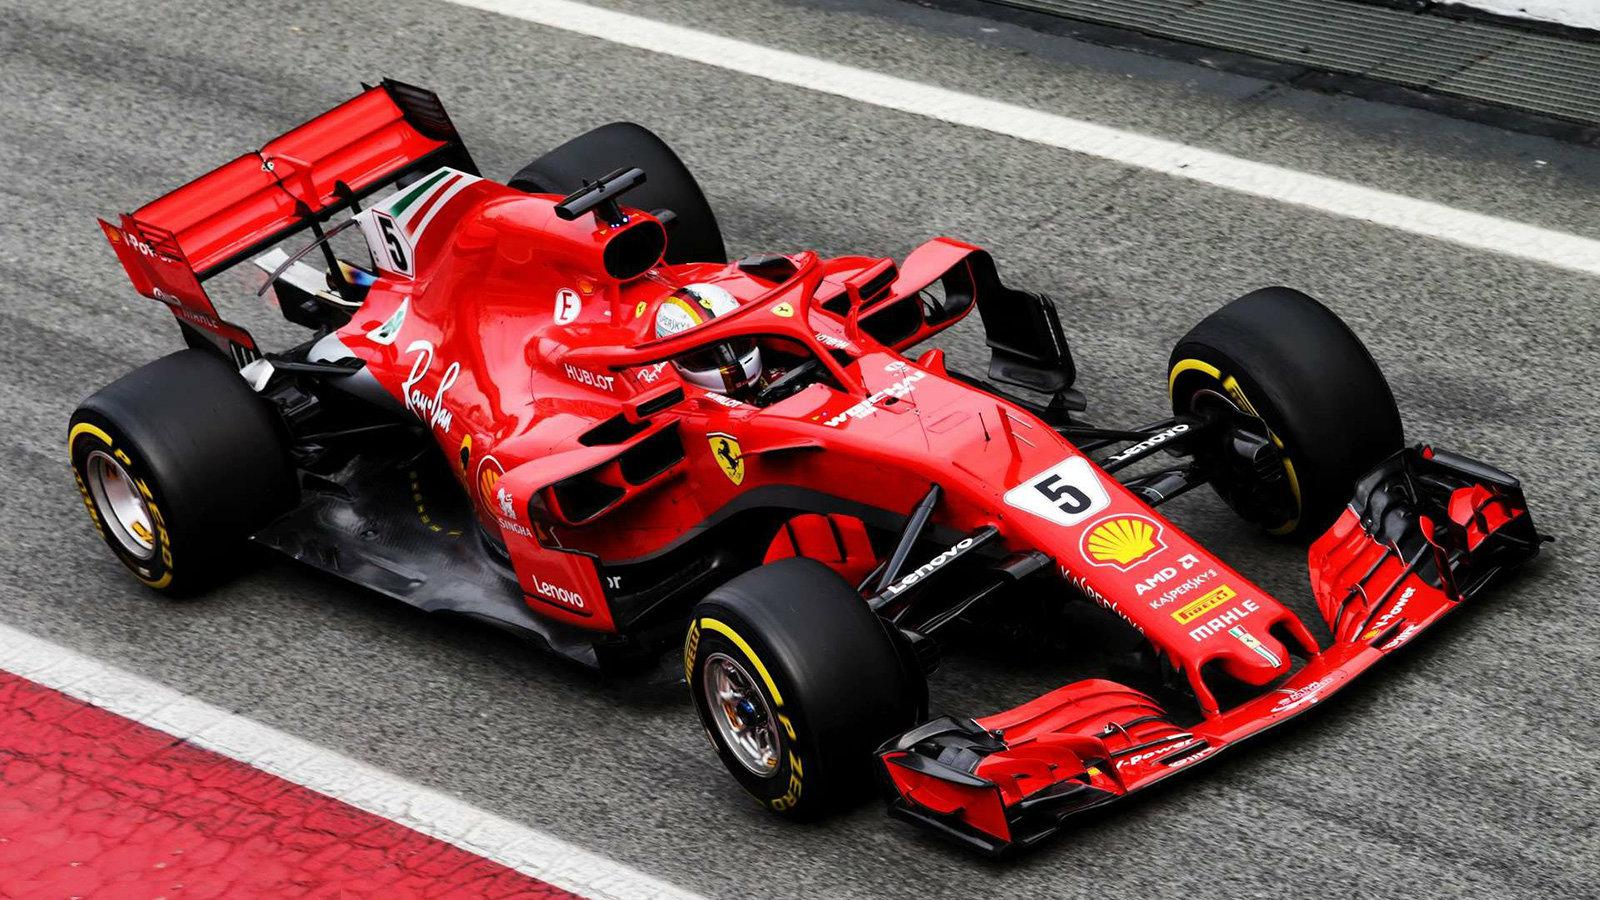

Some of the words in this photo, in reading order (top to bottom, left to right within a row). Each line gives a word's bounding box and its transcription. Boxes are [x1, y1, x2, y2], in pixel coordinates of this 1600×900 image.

[378, 215, 408, 271] 5
[560, 292, 572, 320] E
[564, 363, 615, 392] HUBLOT
[1109, 424, 1189, 461] Lenovo
[1034, 473, 1092, 515] 5
[498, 518, 533, 538] SINGHA
[887, 537, 974, 594] Lenovo
[1134, 567, 1178, 596] AMD
[532, 574, 584, 608] Lenovo
[1188, 599, 1260, 642] MAHLE
[778, 712, 797, 742] P
[771, 749, 804, 811] ZERO
